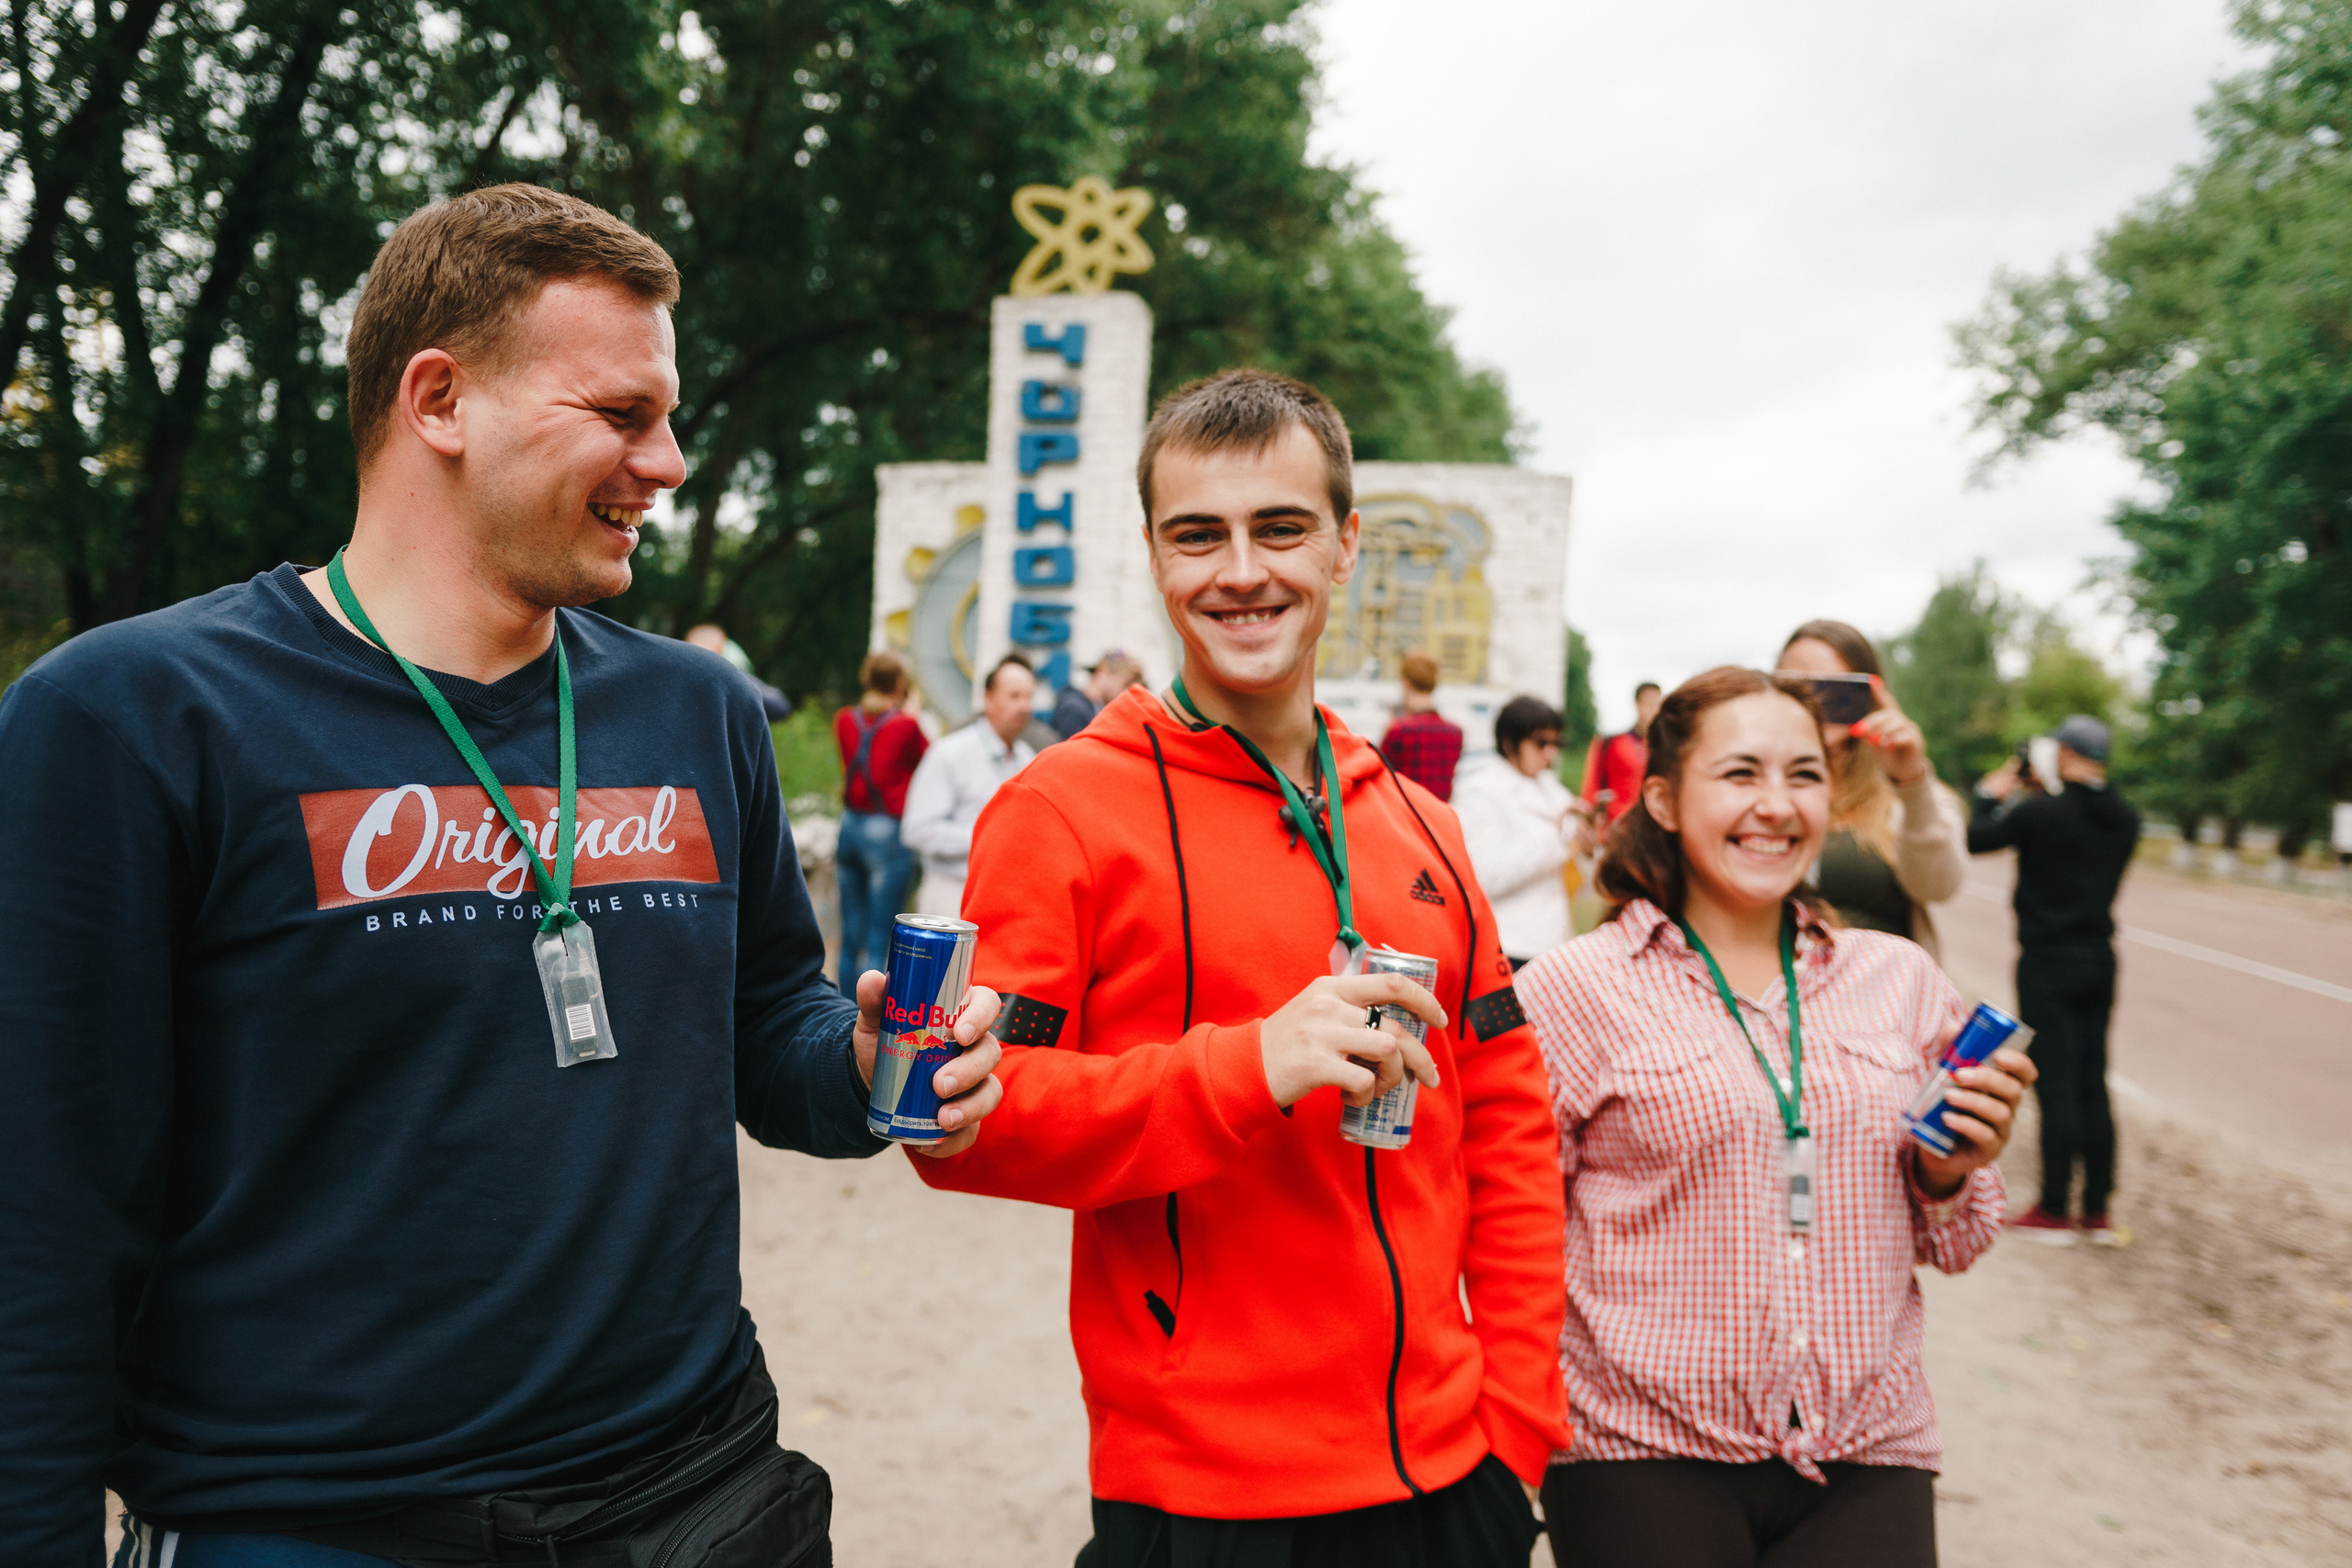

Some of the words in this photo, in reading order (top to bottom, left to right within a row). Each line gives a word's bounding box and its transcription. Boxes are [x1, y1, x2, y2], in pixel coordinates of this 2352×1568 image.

[342, 784, 676, 899] Original
[367, 905, 477, 931] BRAND
[496, 904, 543, 919] FOR
[567, 896, 623, 914] THE
[643, 893, 697, 908] BEST
[885, 996, 925, 1026] Red
[882, 1043, 922, 1061] ENERGY
